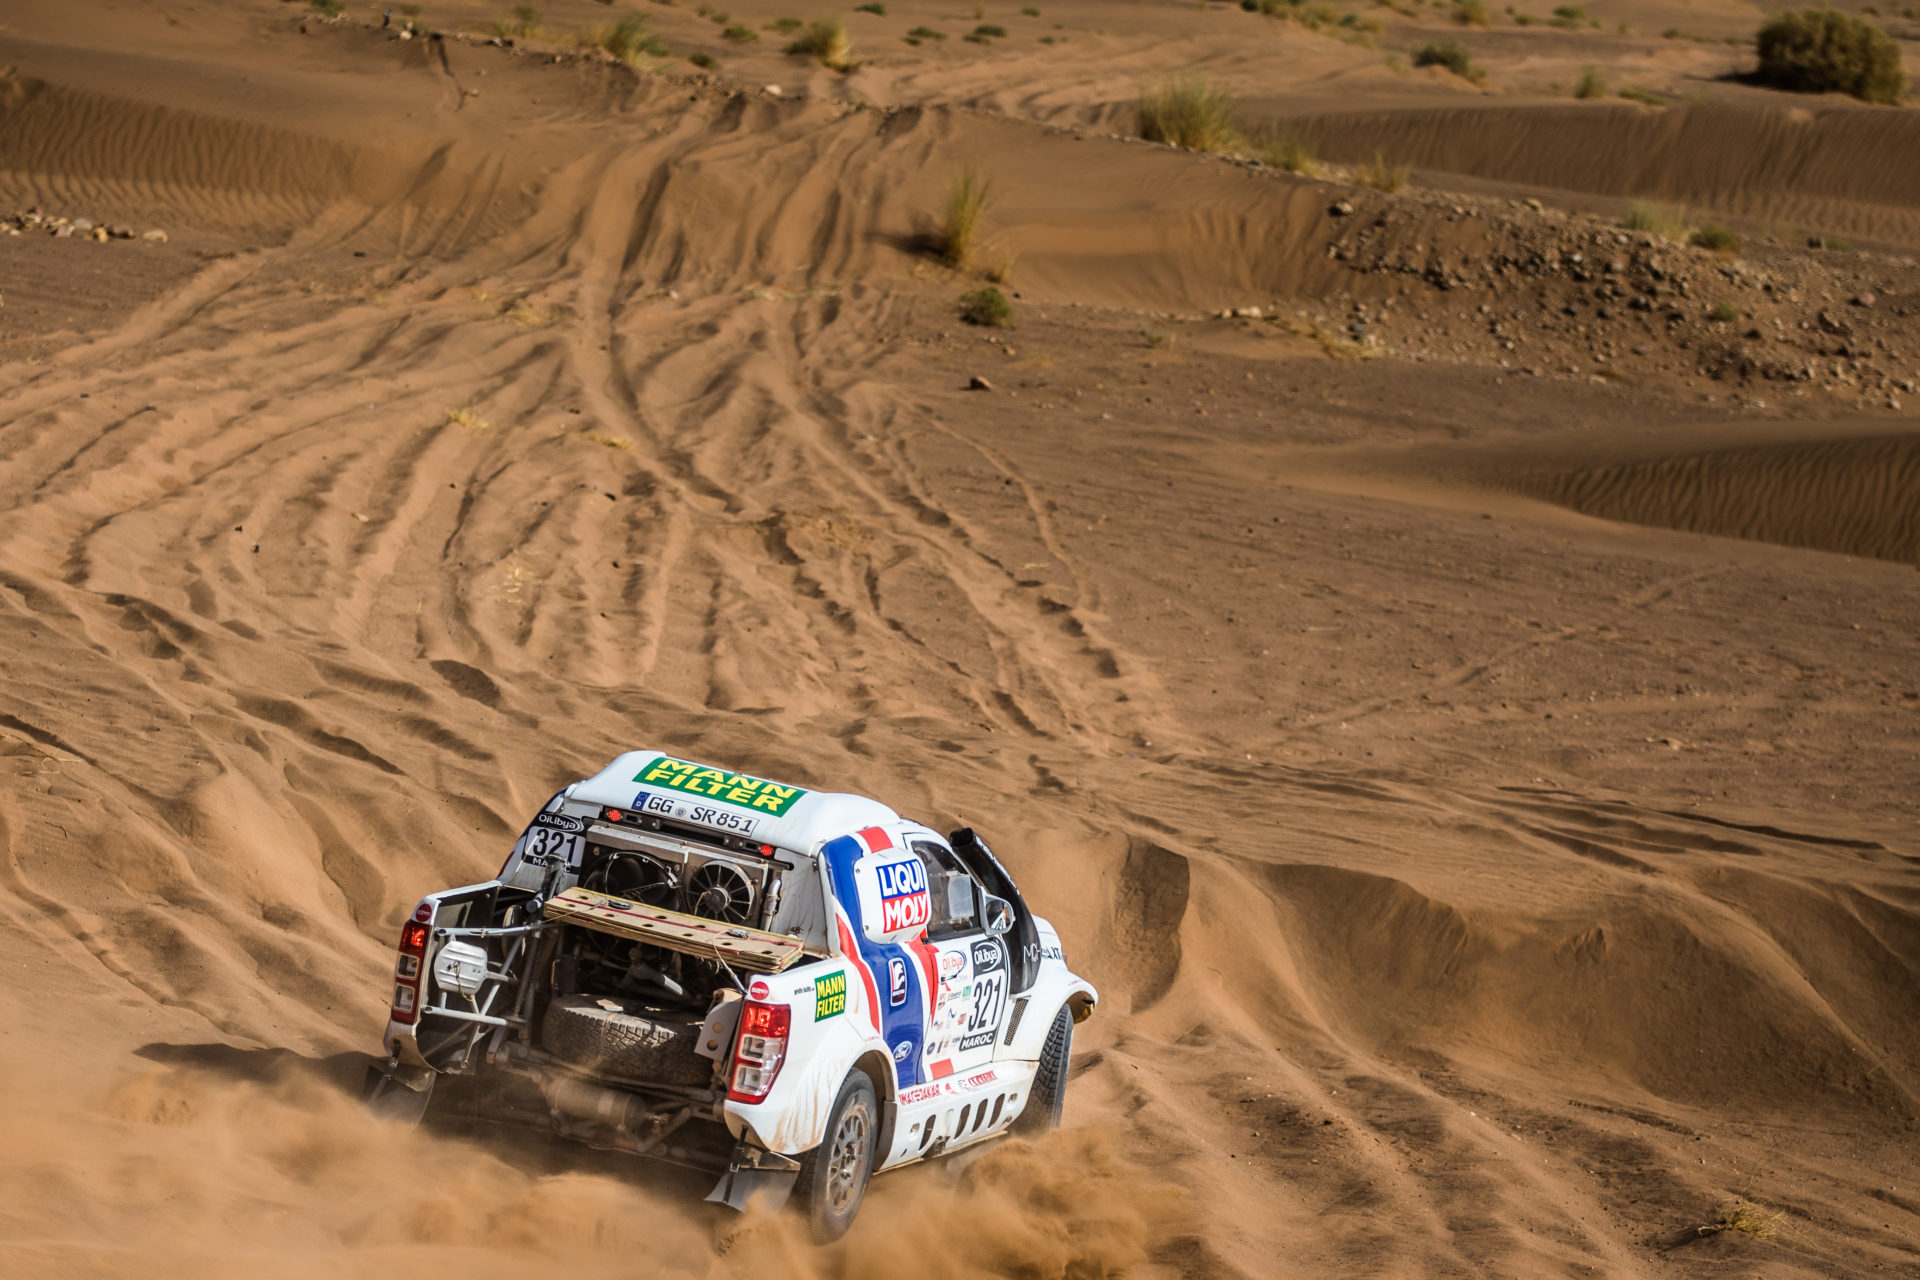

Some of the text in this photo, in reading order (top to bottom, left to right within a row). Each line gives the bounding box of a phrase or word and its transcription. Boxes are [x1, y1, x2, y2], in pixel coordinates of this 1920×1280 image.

[644, 768, 784, 812] FILTER
[657, 759, 797, 799] MANN
[647, 796, 753, 833] GG SR 851
[533, 828, 577, 863] 321
[878, 861, 925, 897] LIQUI
[884, 894, 928, 931] MOLY
[816, 974, 845, 1000] MANN
[968, 975, 1002, 1032] 321
[816, 993, 845, 1018] FILTER
[961, 1033, 993, 1050] MAROC
